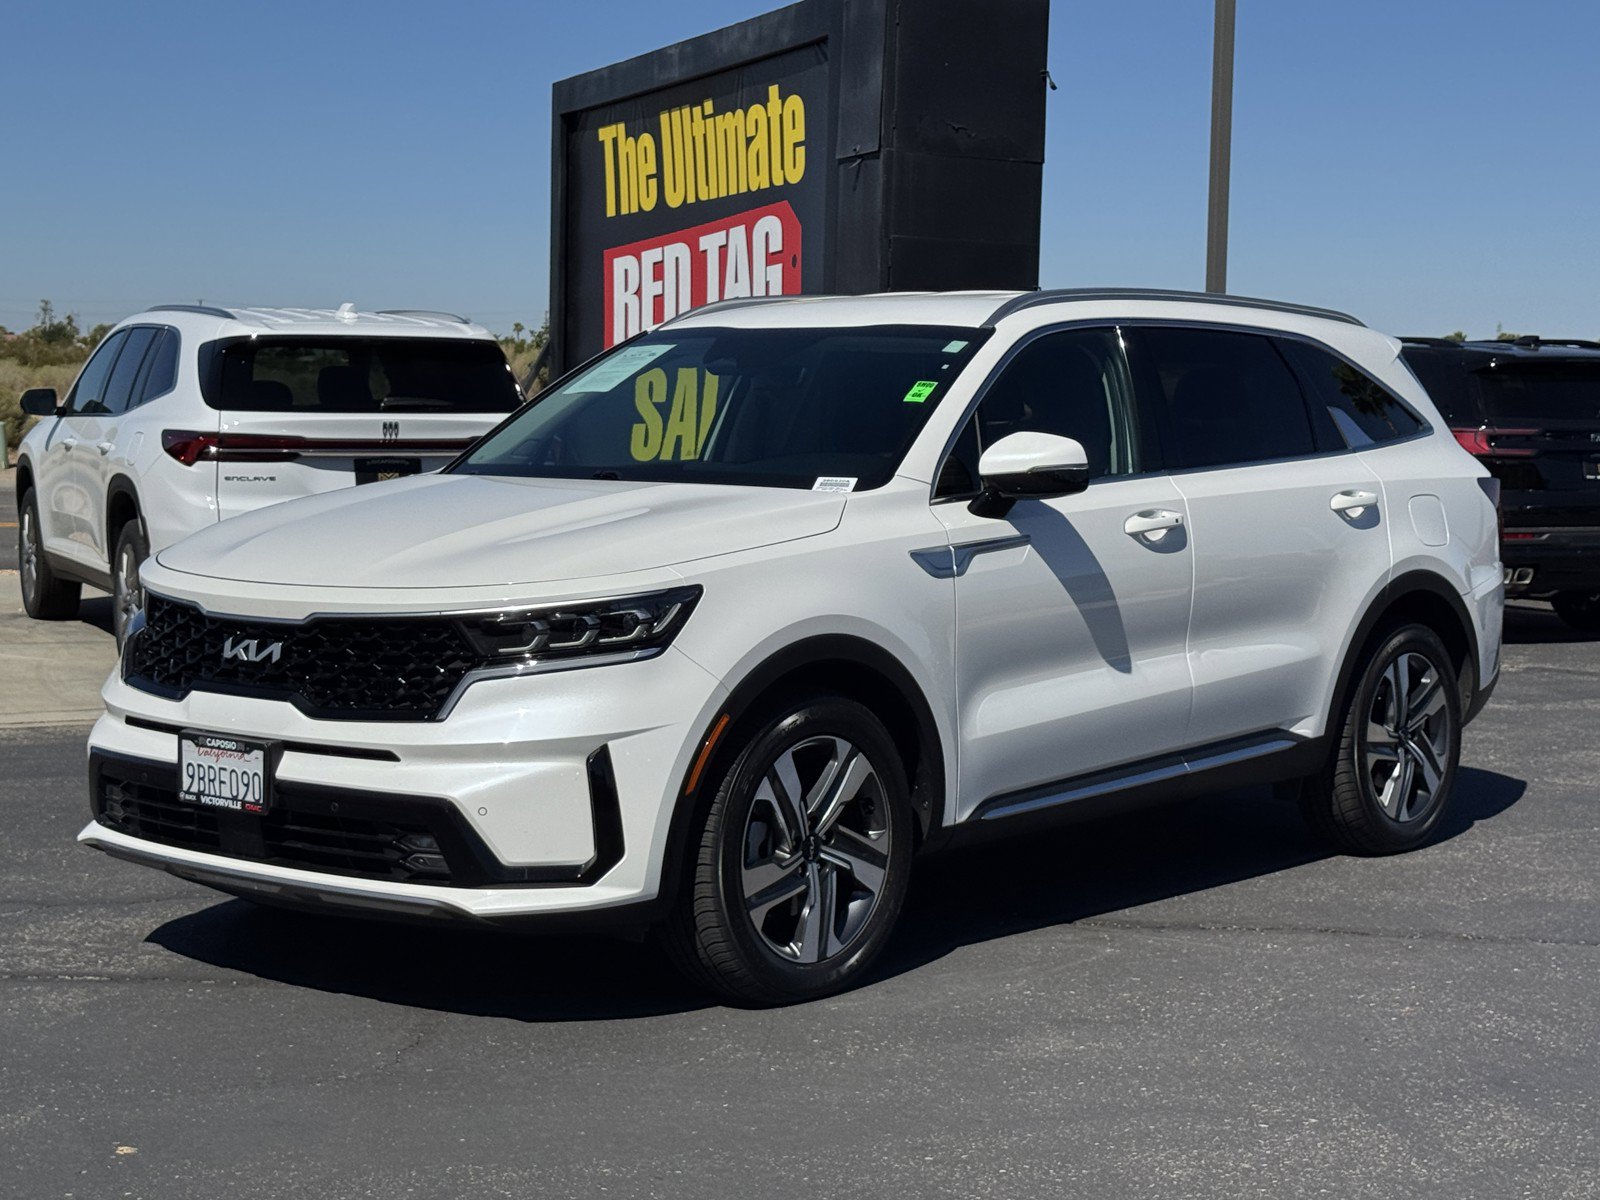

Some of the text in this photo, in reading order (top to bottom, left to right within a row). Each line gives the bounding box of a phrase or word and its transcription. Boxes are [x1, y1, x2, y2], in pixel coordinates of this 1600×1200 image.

[598, 84, 806, 218] The Ultimate
[613, 215, 783, 345] RED TAG
[223, 636, 282, 663] KIA
[206, 738, 237, 750] CAPOSIO
[186, 762, 262, 803] 9BRF090
[200, 795, 242, 809] VICTORVILLE
